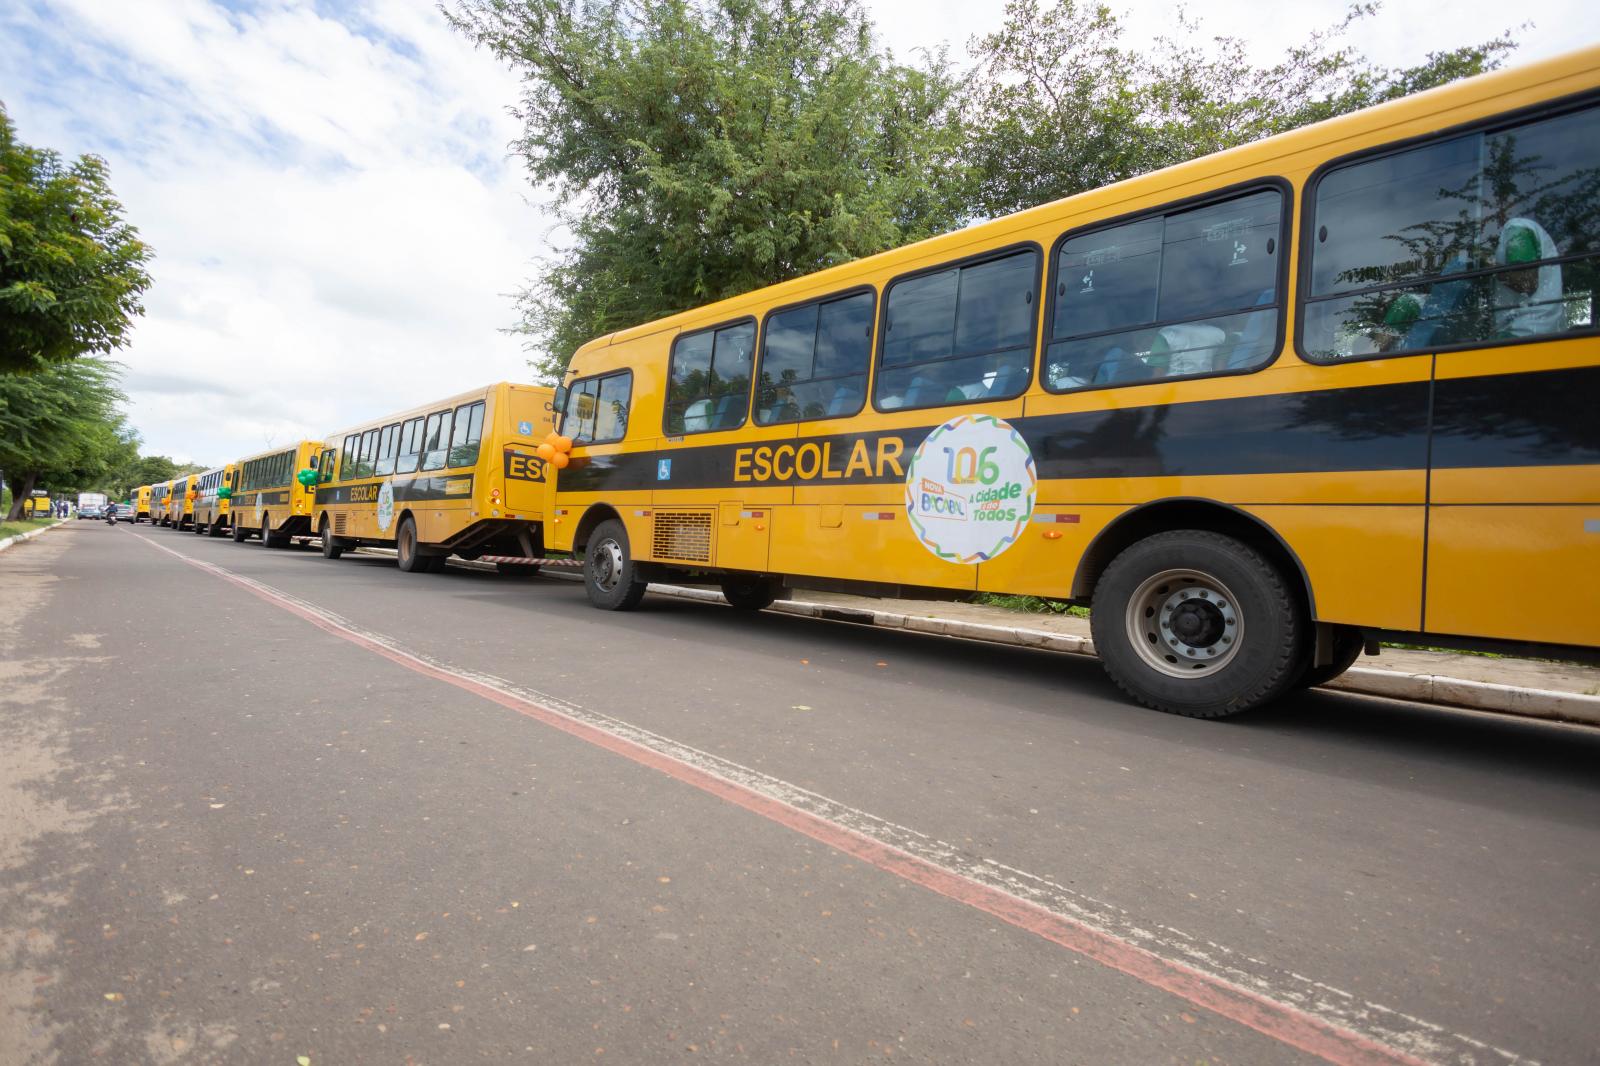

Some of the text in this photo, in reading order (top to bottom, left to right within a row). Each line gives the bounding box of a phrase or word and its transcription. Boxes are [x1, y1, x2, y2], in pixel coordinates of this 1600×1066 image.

[734, 437, 904, 481] ESCOLAR
[943, 446, 1000, 485] 106
[351, 485, 378, 501] ESCOLAR
[924, 481, 942, 492] NOVA
[976, 482, 1022, 503] Cidade
[973, 508, 1016, 521] Todos
